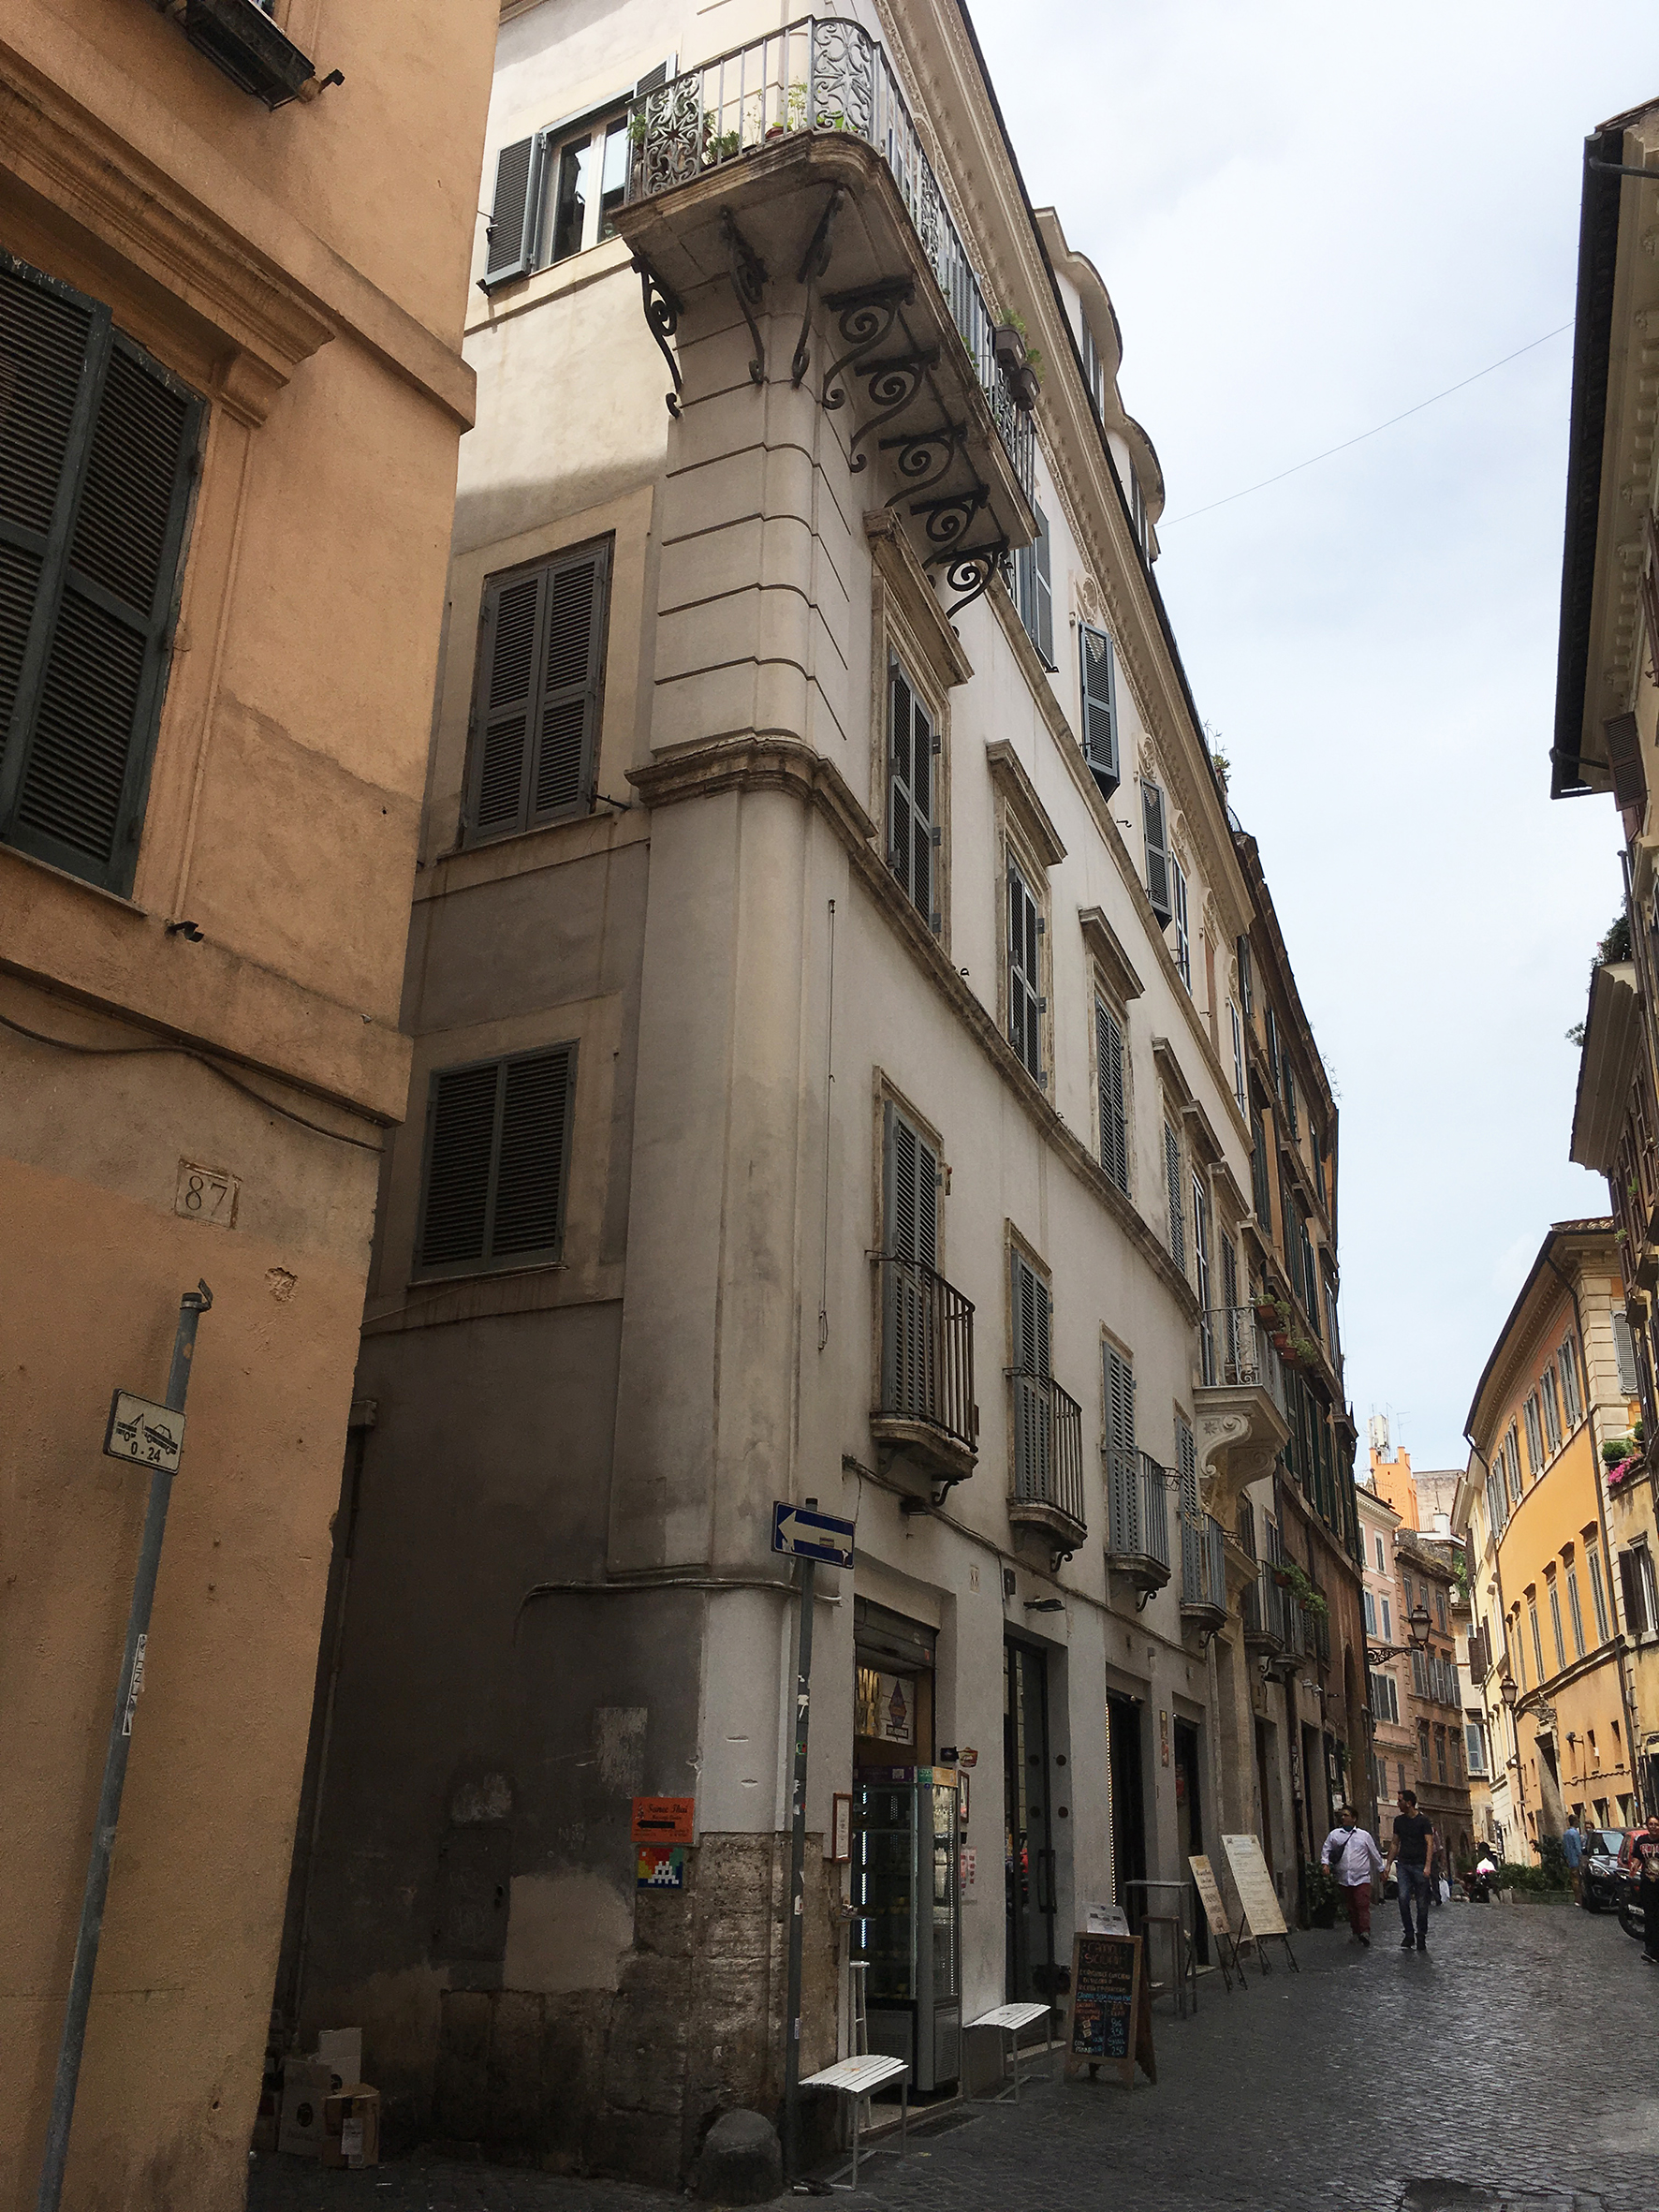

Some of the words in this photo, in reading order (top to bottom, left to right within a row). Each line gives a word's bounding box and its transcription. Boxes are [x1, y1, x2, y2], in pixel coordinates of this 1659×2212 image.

[184, 1174, 228, 1217] 87
[130, 1440, 139, 1455] 0
[146, 1446, 161, 1463] 24
